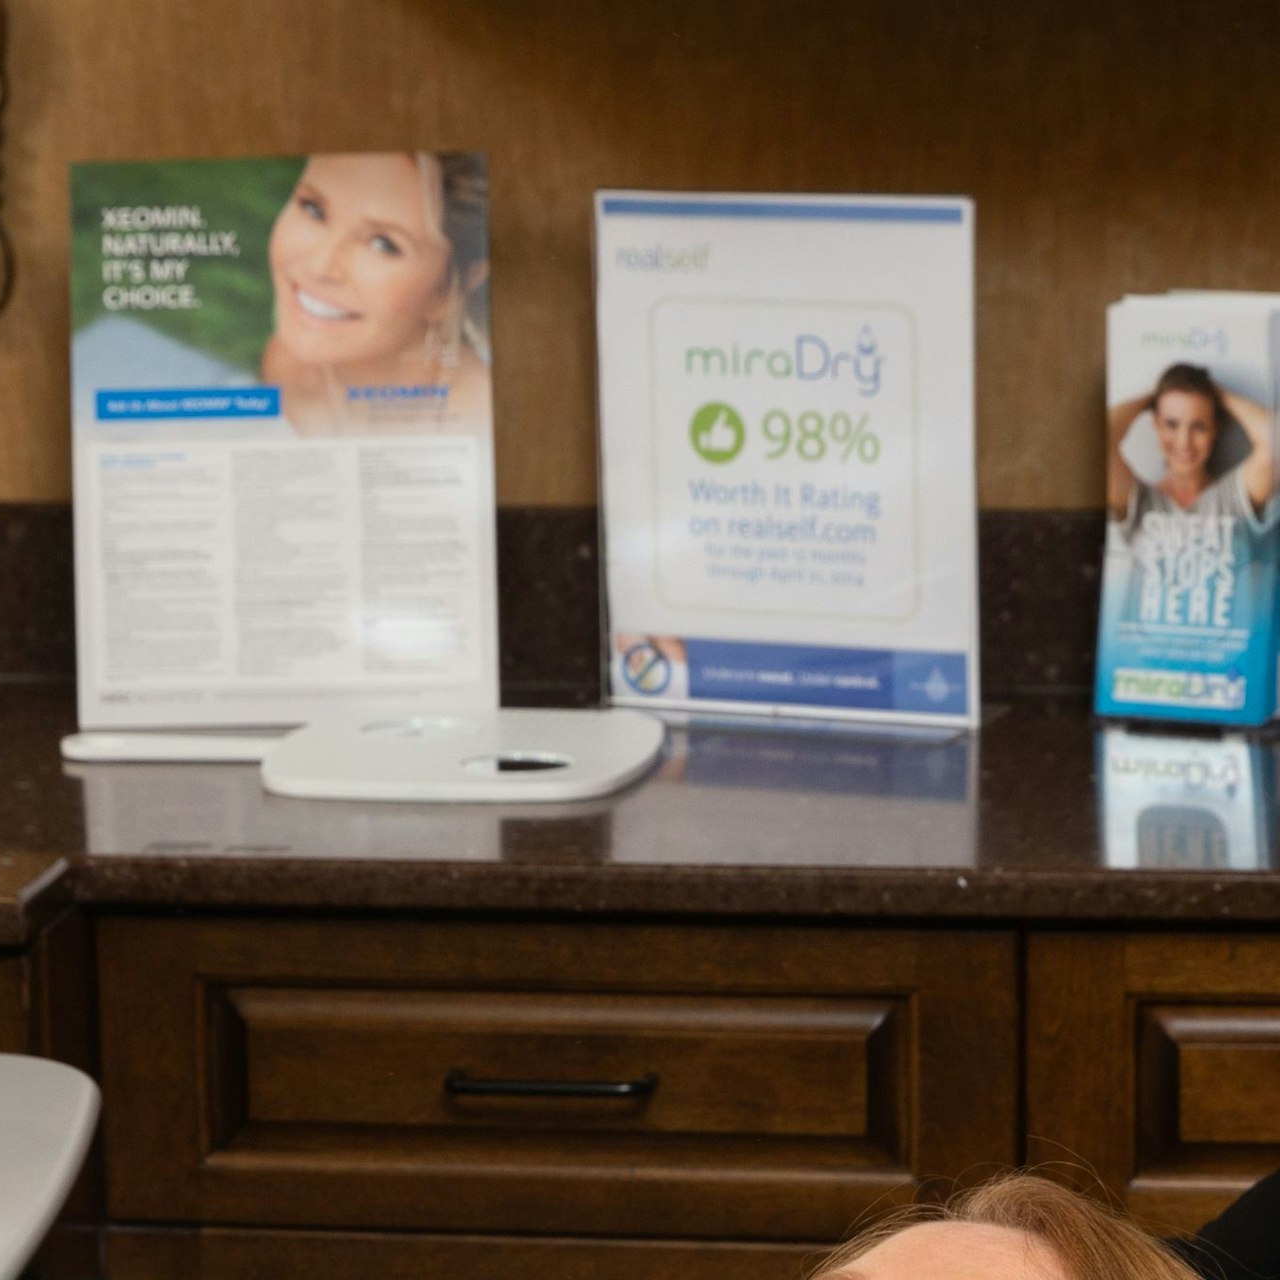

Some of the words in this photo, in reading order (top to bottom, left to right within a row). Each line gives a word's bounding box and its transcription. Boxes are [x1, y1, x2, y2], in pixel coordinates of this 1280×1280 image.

[101, 206, 206, 231] XEOMIN.
[102, 260, 145, 282] IT'S
[150, 259, 189, 281] MY
[616, 243, 710, 273] realself
[103, 285, 200, 310] CHOICE.
[685, 326, 886, 398] miraDry
[761, 409, 882, 465] 98%
[688, 479, 767, 507] Worth
[801, 484, 881, 518] Rating
[689, 516, 719, 537] on
[727, 514, 877, 545] realself.com
[1142, 511, 1234, 551] SWEAT
[1142, 548, 1235, 590] STOPS
[1140, 582, 1233, 627] HERE
[1114, 668, 1245, 705] miraDry
